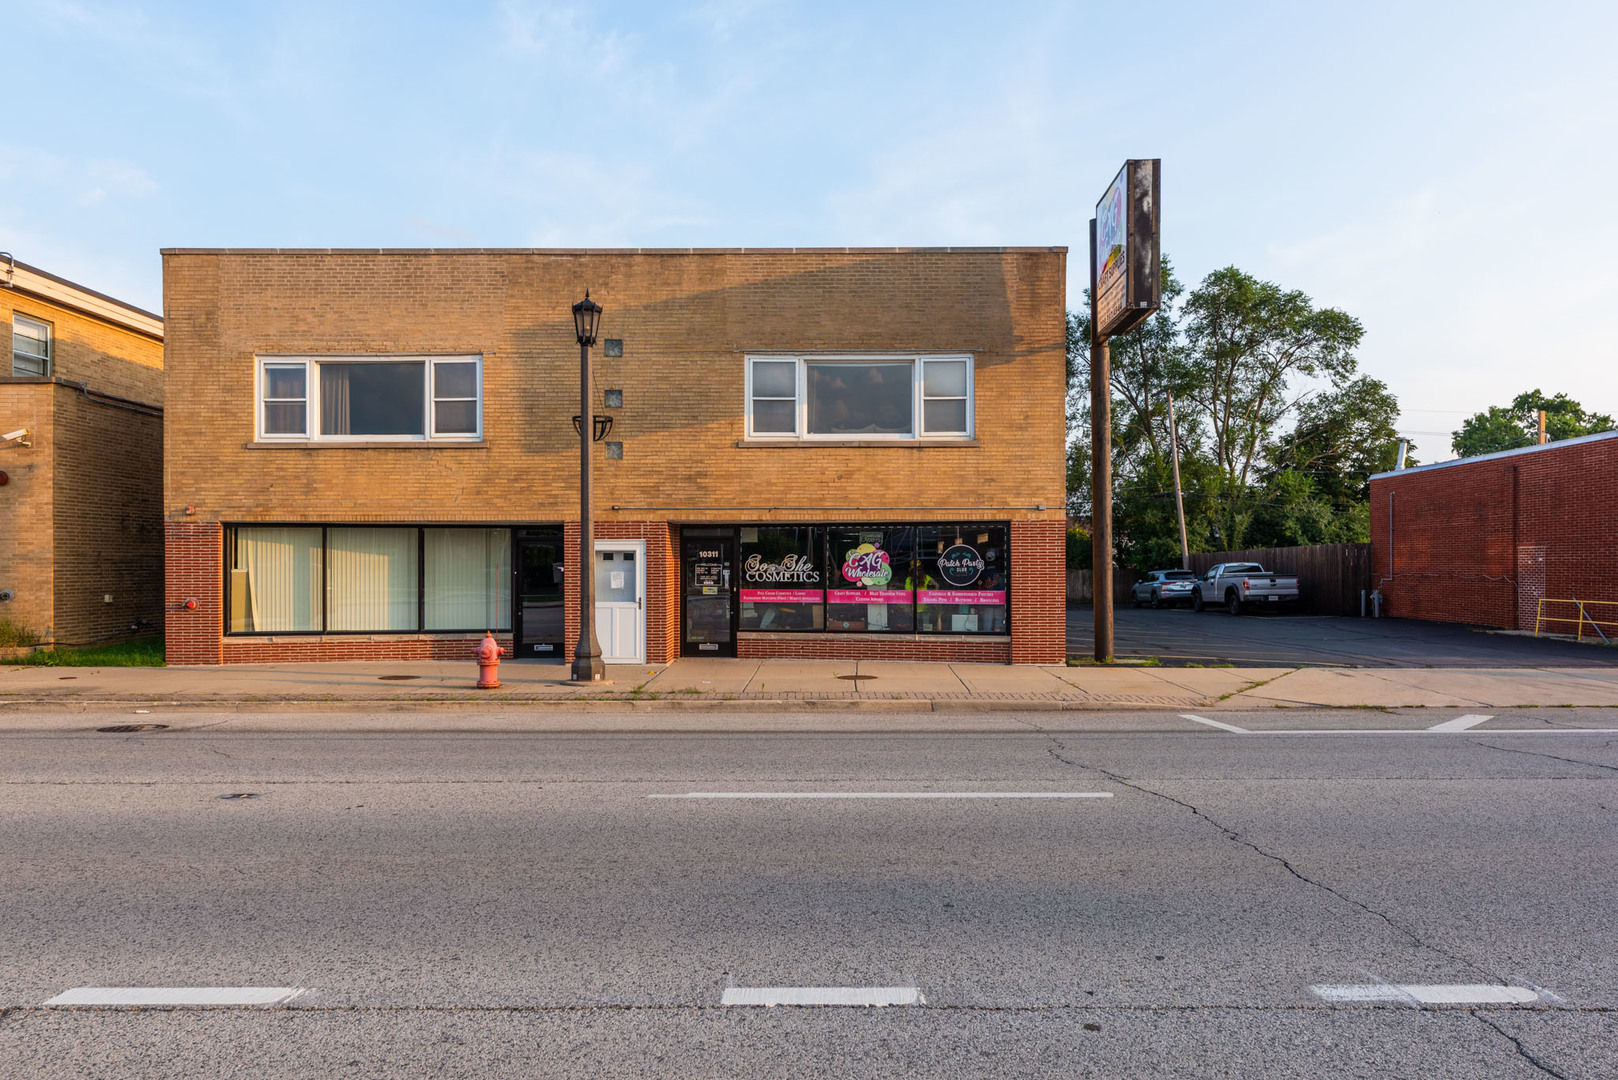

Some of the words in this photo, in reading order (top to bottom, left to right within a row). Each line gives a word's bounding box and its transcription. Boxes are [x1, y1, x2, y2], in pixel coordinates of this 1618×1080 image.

[699, 550, 719, 558] 10311
[744, 553, 768, 575] So
[781, 553, 814, 572] She
[848, 551, 885, 569] CAG
[939, 559, 960, 567] Patch
[962, 558, 983, 570] Party
[746, 571, 820, 582] COSMETICS
[845, 567, 889, 578] Wholesale
